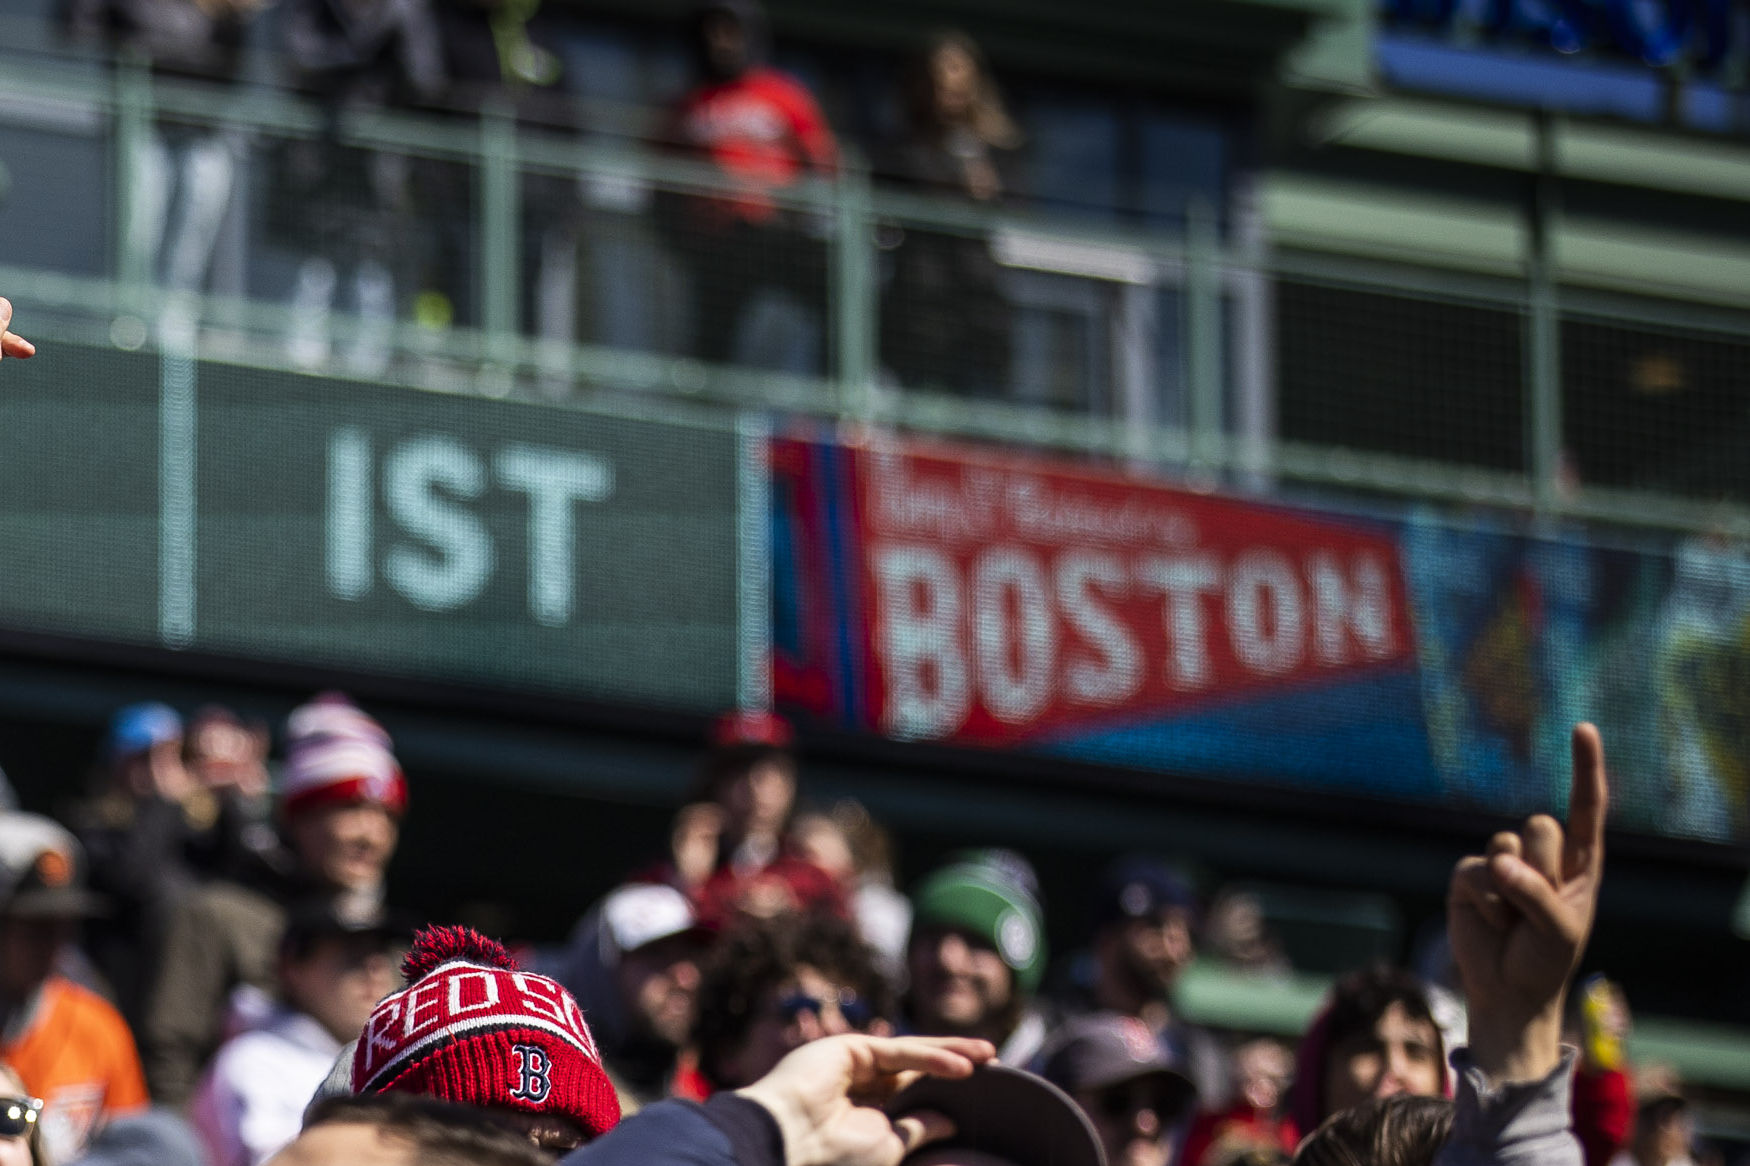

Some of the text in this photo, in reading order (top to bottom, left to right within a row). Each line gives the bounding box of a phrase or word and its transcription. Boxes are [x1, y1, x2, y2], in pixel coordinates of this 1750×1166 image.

[873, 541, 1395, 742] BOSTON
[364, 971, 500, 1071] RED
[510, 1044, 552, 1104] B
